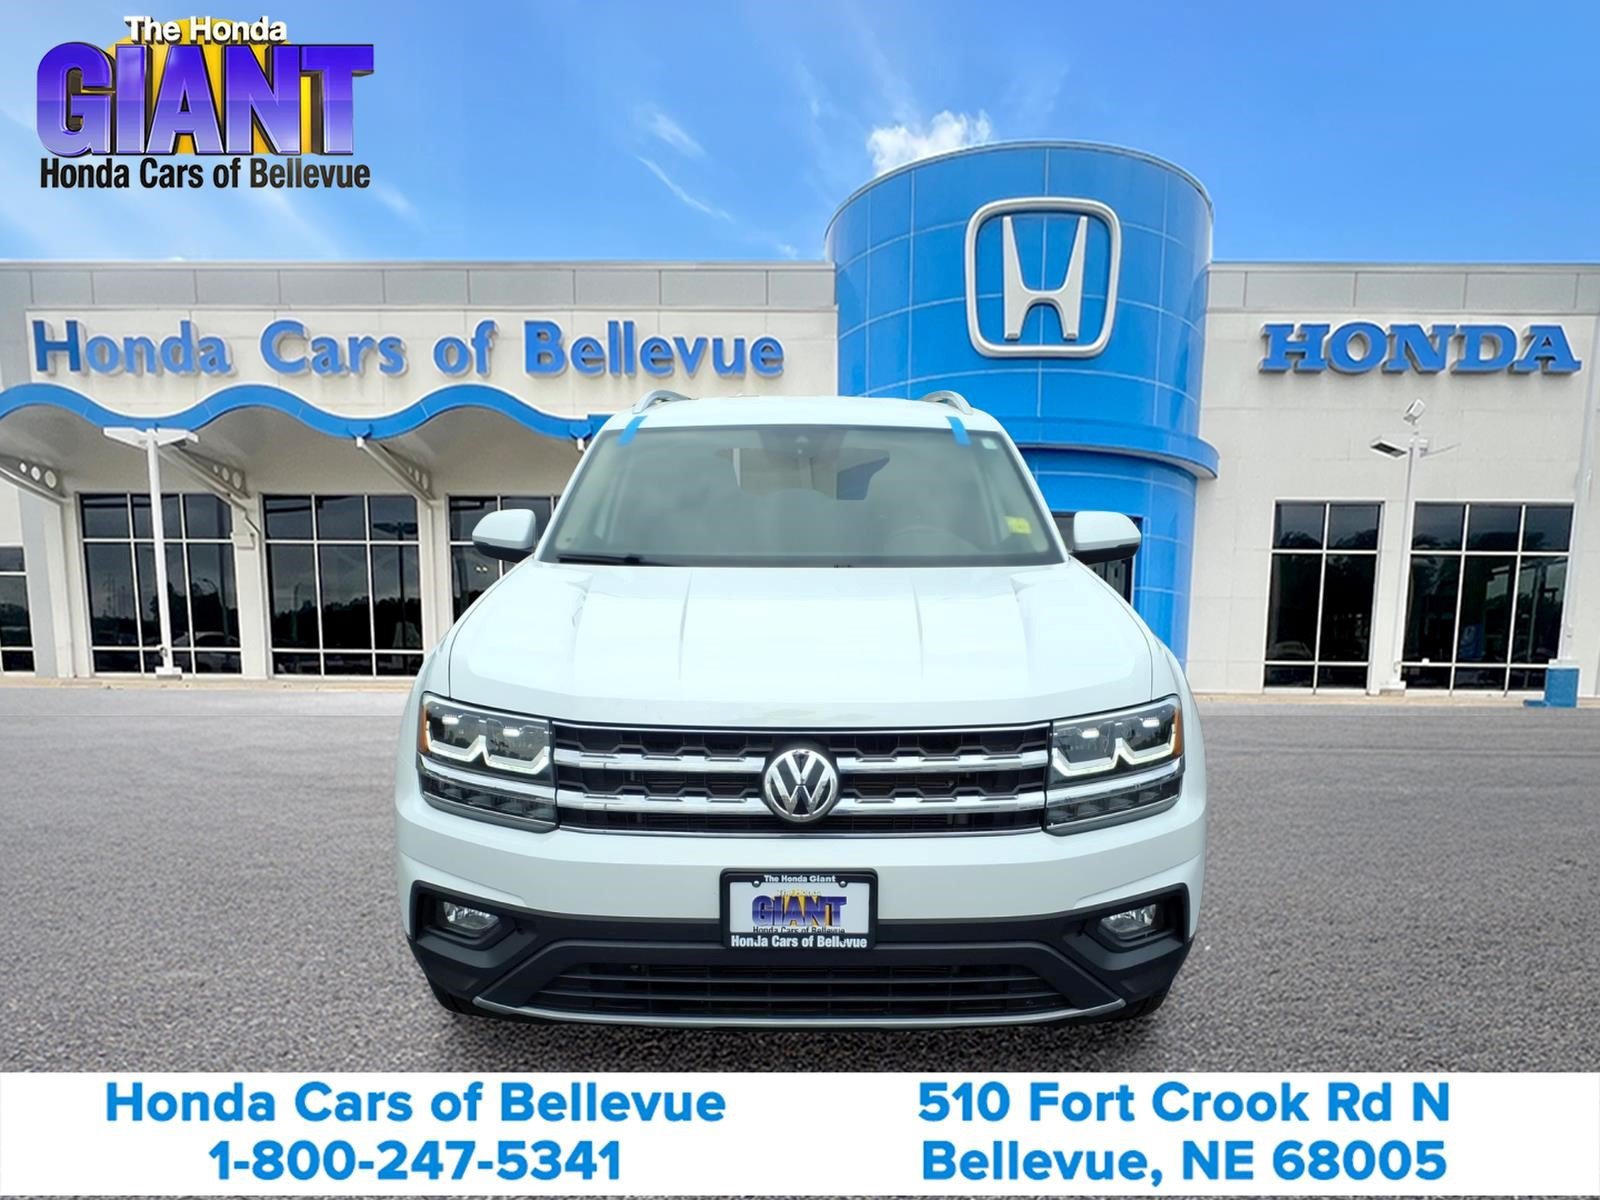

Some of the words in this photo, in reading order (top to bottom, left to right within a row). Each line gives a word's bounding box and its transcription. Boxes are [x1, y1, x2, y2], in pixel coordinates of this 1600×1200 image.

[32, 319, 234, 375] Honda
[260, 319, 407, 375] Cars
[433, 319, 498, 377] of
[523, 319, 785, 379] Bellevue
[1259, 322, 1582, 376] HONDA
[764, 874, 779, 883] The
[781, 874, 808, 883] Honda
[809, 874, 836, 883] Giant
[752, 895, 847, 926] GIANT
[771, 935, 799, 948] Cars
[801, 935, 814, 948] of
